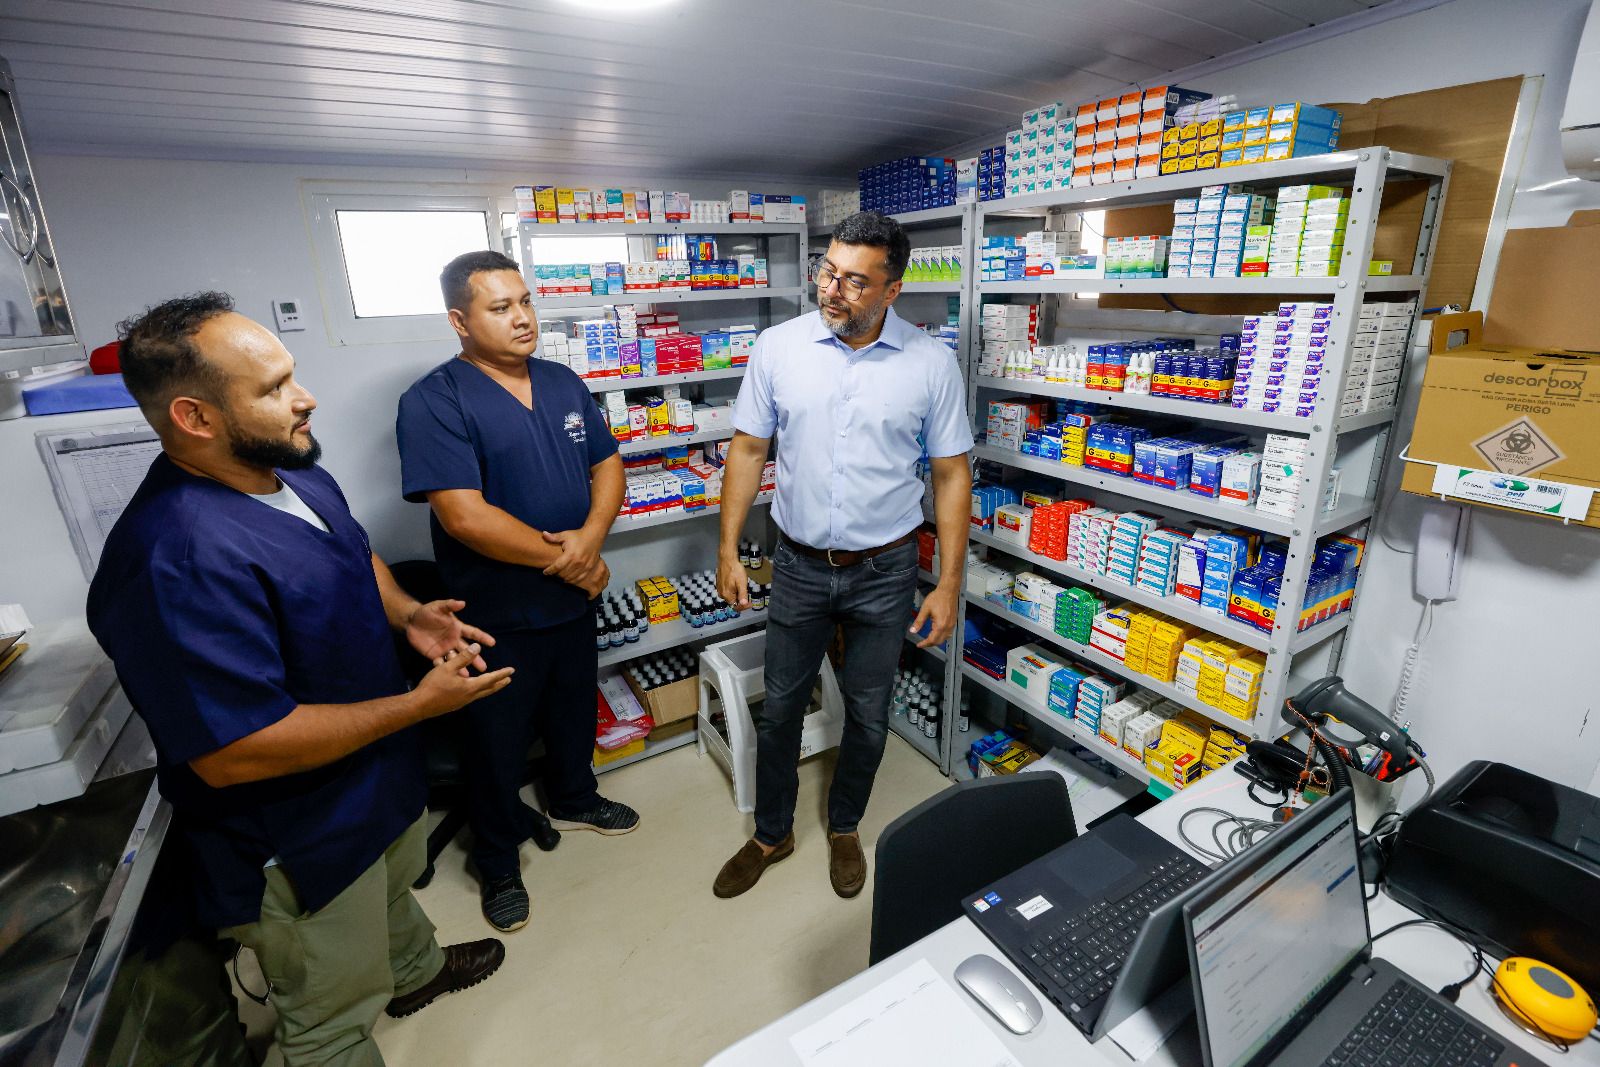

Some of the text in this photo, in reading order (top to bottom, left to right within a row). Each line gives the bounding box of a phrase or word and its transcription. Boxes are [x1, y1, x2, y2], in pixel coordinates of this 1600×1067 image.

[1483, 372, 1584, 390] descarbox
[1506, 403, 1551, 414] PERIGO
[1234, 596, 1242, 605] G
[1262, 608, 1270, 618] G
